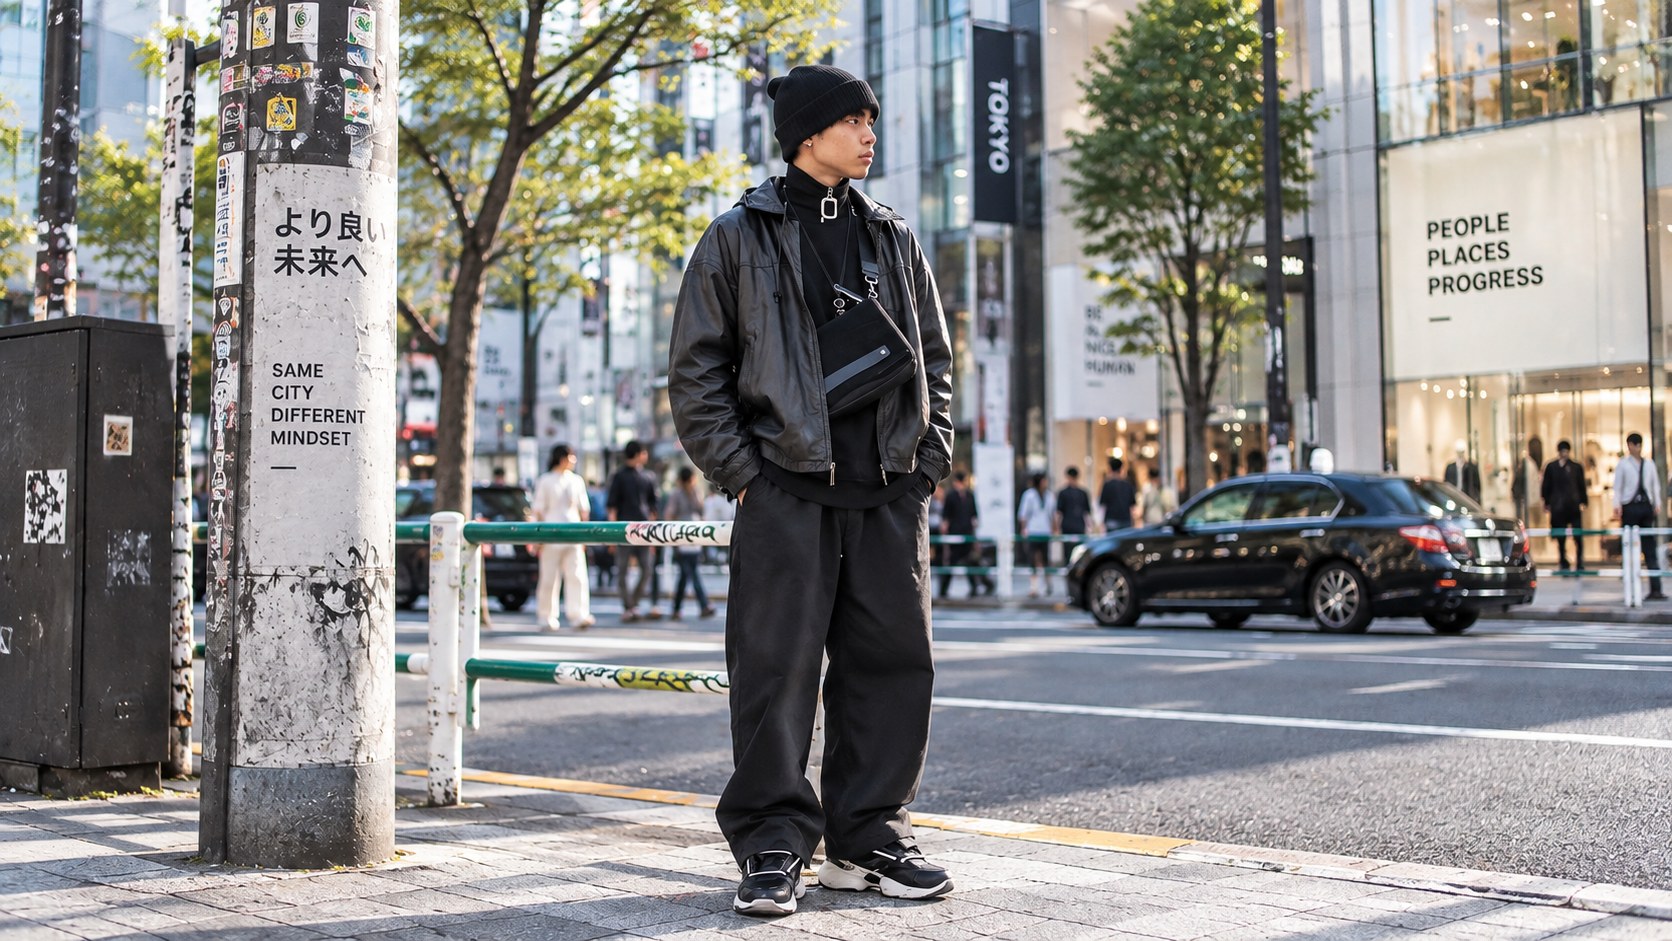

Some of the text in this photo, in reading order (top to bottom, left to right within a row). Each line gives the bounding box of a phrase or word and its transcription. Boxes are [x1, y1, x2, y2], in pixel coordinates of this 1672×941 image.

[987, 77, 1010, 175] TOKYO
[274, 207, 386, 243] より良い
[1427, 212, 1510, 241] PEOPLE
[274, 243, 369, 278] 未来へ
[1427, 240, 1511, 269] PLACES
[1428, 265, 1544, 296] PROGRESS
[272, 362, 324, 379] SAME
[271, 384, 315, 401] CITY
[271, 407, 366, 425] DIFFERENT
[270, 430, 353, 446] MINDSET
